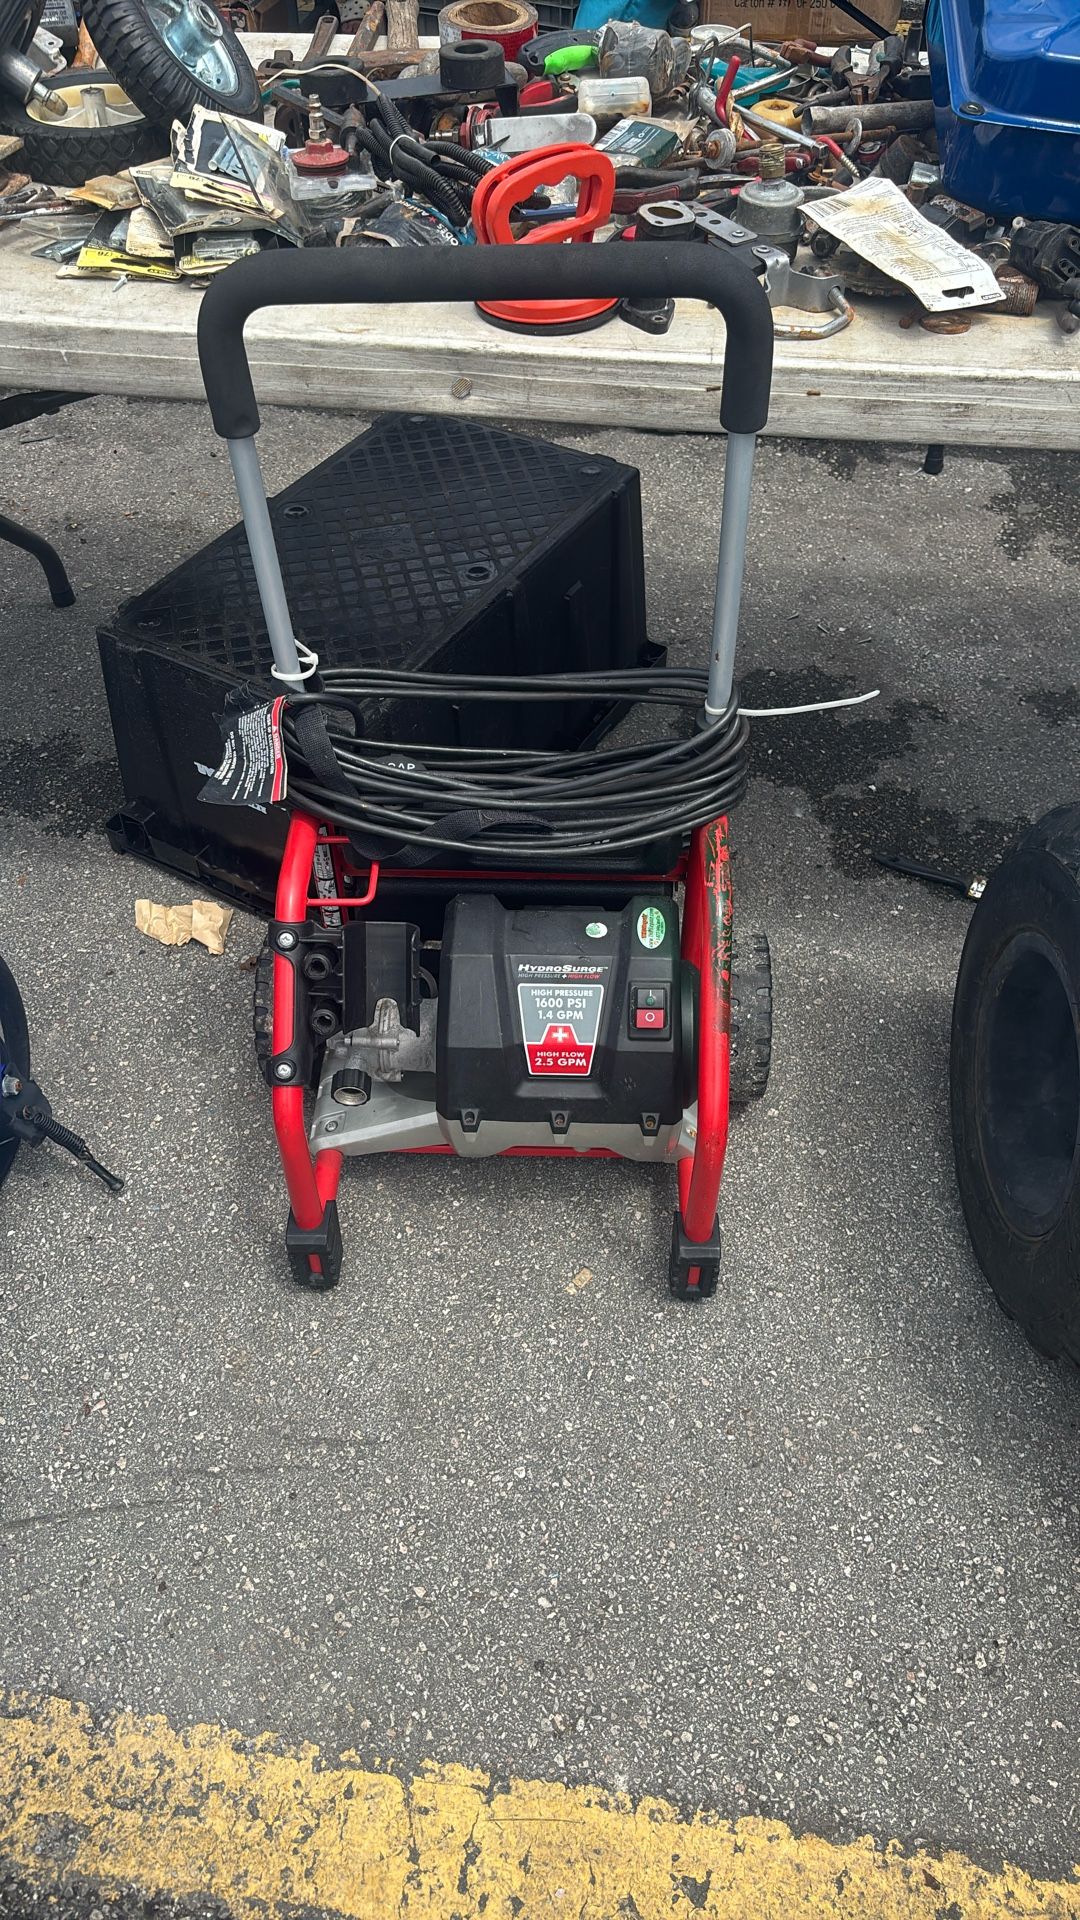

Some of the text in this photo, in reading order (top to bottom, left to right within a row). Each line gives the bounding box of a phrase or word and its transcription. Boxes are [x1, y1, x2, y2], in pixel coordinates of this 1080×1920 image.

[436, 223, 459, 246] ODES
[273, 733, 281, 759] DANGER
[531, 989, 593, 997] HIGH PRESSURE
[536, 998, 586, 1008] 1600 PSI
[539, 1010, 584, 1020] 1.4 GPM
[534, 1058, 586, 1066] 2.5 GPM
